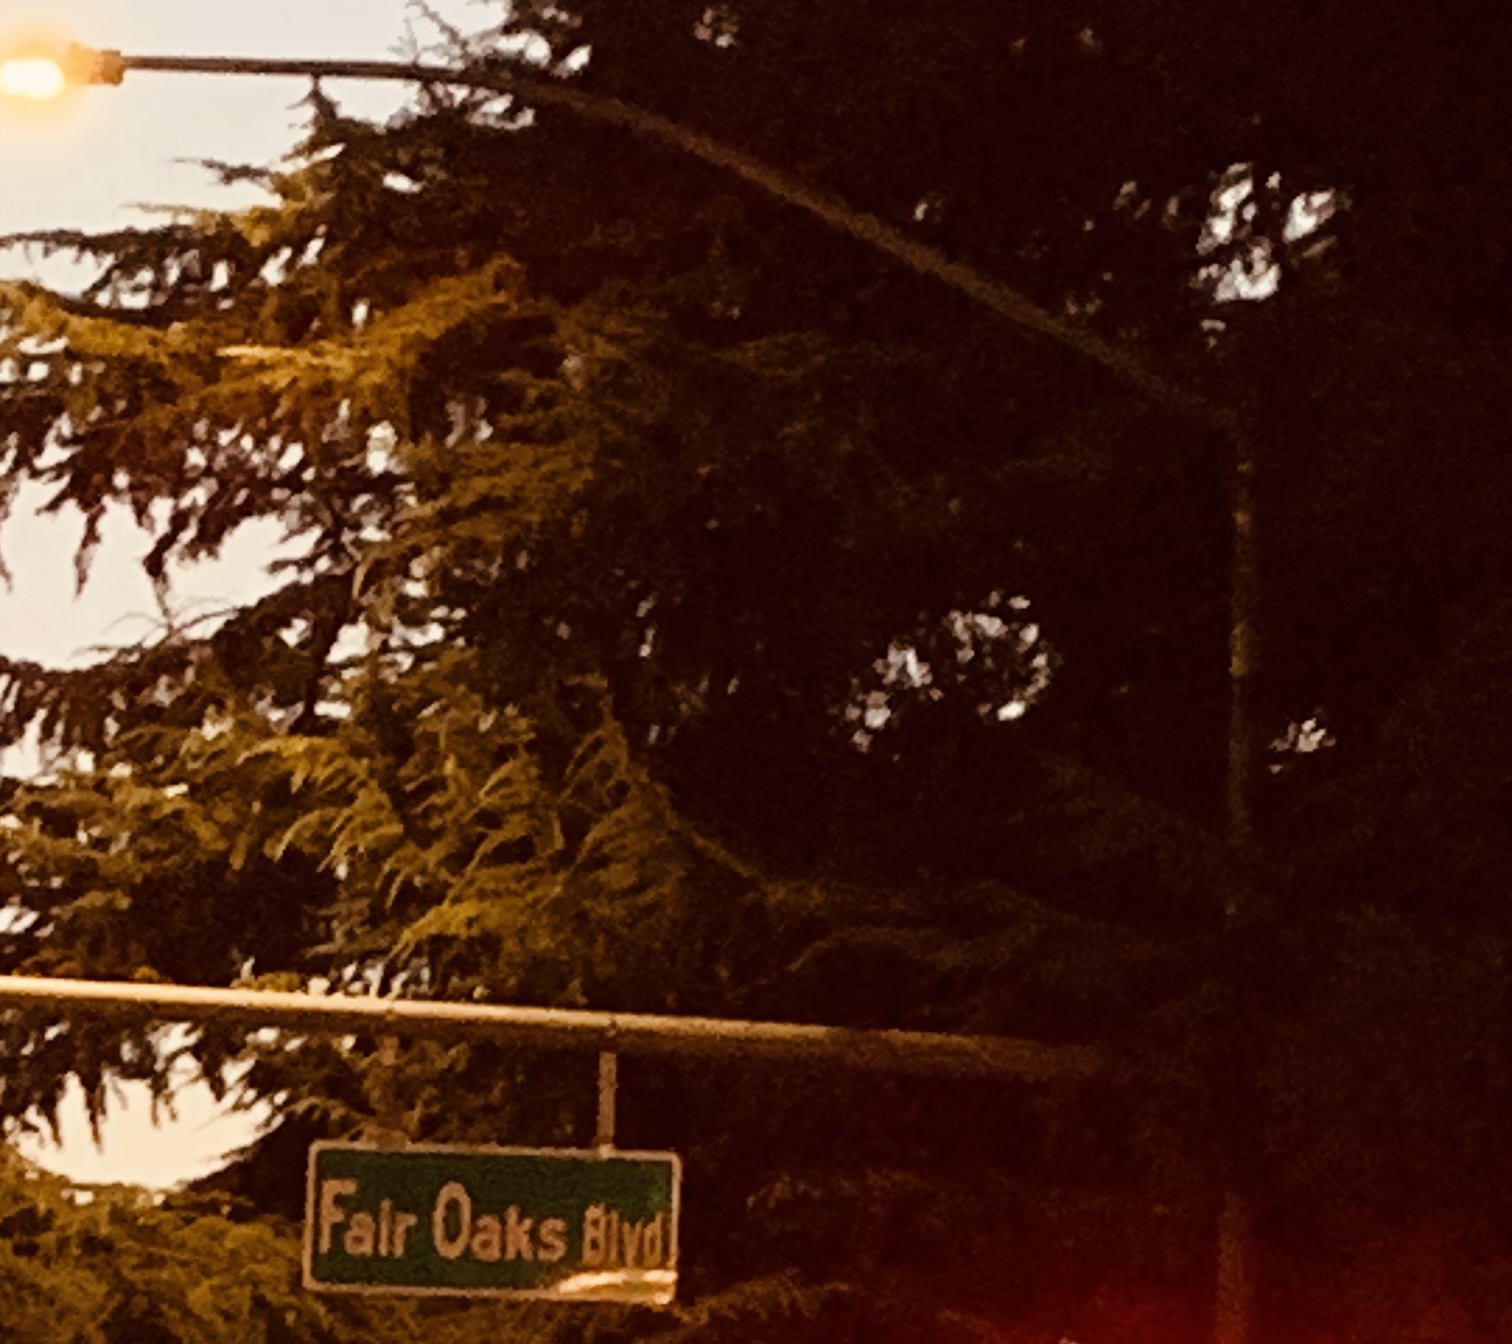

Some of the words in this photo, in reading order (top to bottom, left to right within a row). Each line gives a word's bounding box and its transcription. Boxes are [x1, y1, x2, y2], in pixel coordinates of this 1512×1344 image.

[317, 1178, 418, 1259] Fair
[432, 1180, 569, 1262] Oaks
[580, 1202, 664, 1269] Blvd
